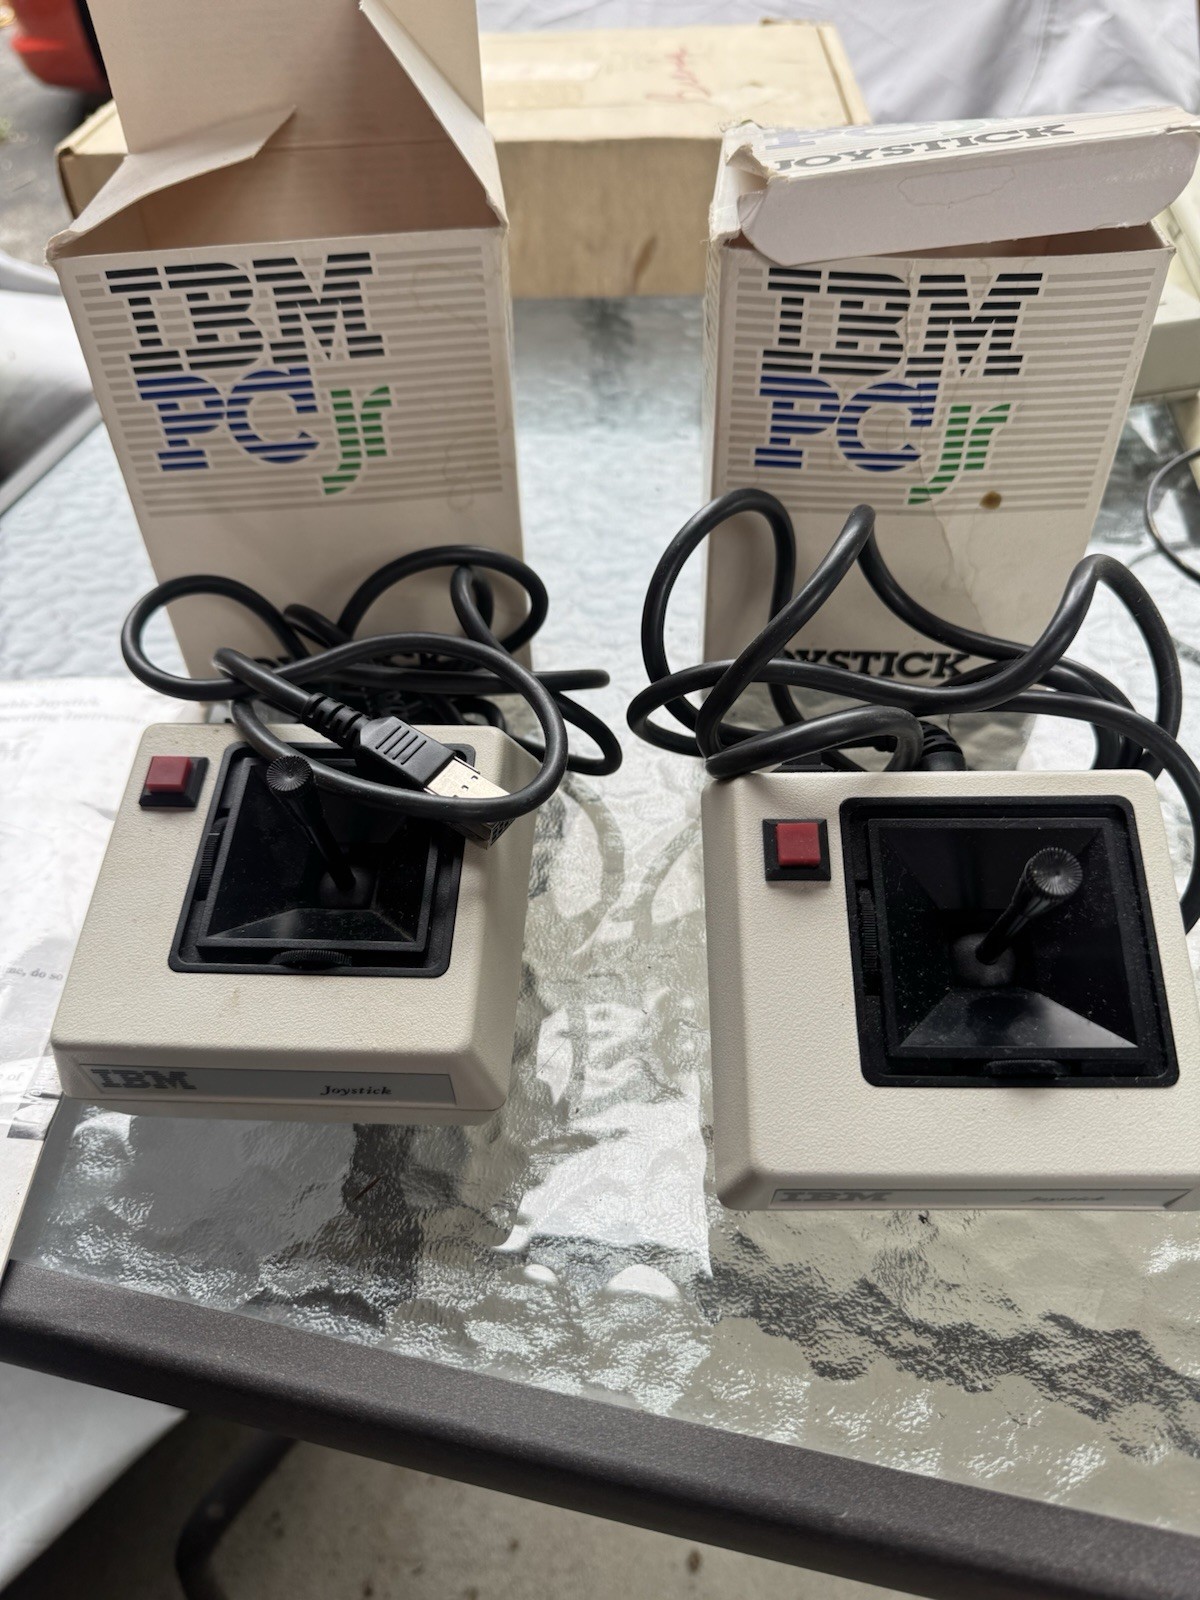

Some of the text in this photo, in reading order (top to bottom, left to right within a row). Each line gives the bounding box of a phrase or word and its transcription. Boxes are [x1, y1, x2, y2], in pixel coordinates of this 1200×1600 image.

[774, 124, 1075, 172] JOYSTICK
[104, 252, 386, 374] IBM
[761, 267, 1044, 379] IBM
[136, 367, 393, 496] PCjr
[753, 375, 1012, 506] PCjr
[783, 649, 970, 679] YSTICK
[31, 968, 46, 979] do
[90, 1069, 392, 1096] IBM Joystick
[780, 1191, 893, 1202] IBM
